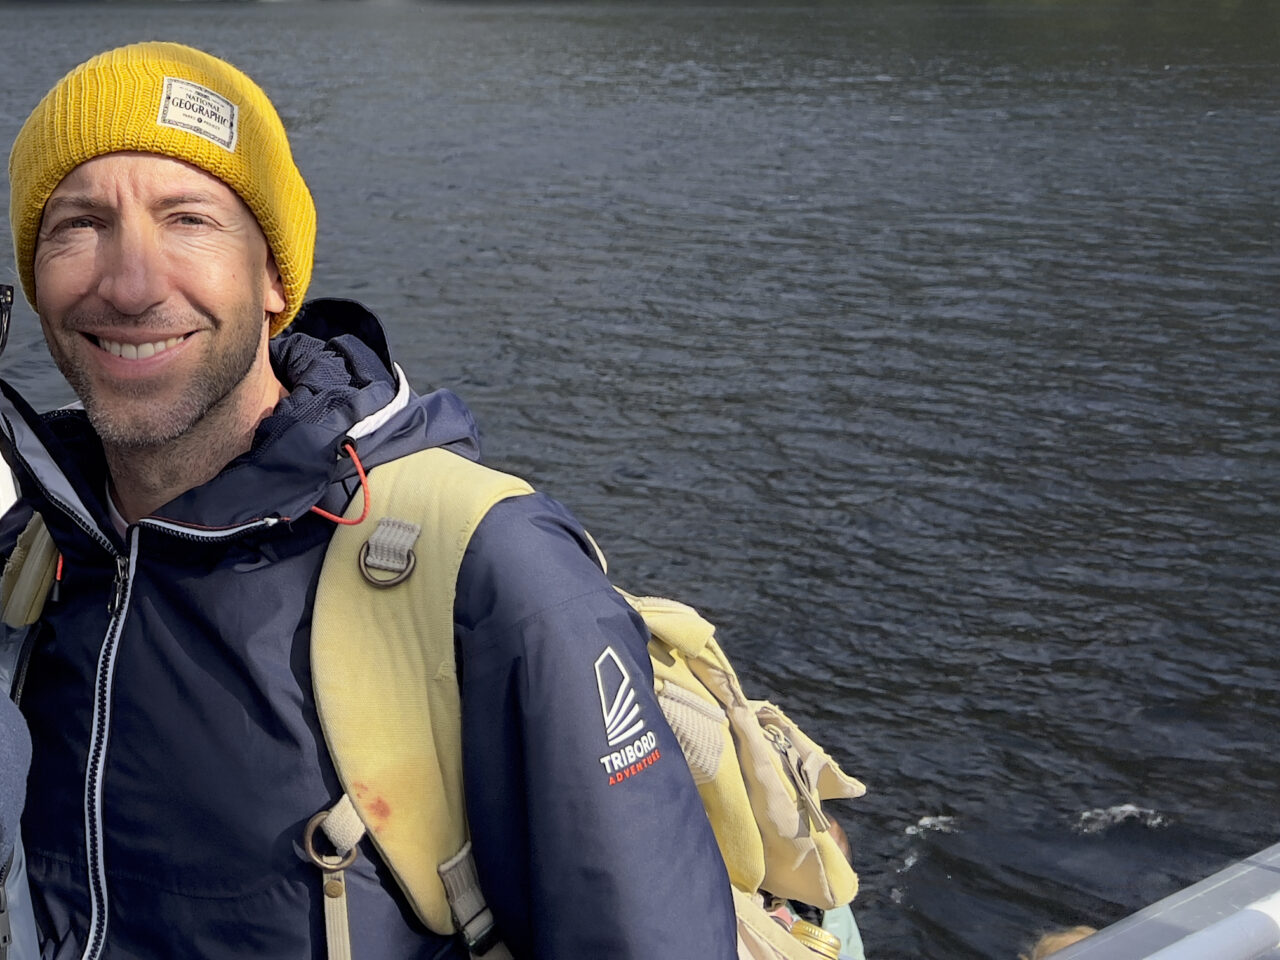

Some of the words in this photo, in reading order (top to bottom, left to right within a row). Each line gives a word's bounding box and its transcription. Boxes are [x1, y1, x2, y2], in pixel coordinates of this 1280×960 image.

[171, 97, 229, 127] GEOGRAPHIC
[186, 93, 220, 112] NATIONAL
[600, 731, 656, 774] TRIBORD
[609, 748, 661, 786] ADVENTURE
